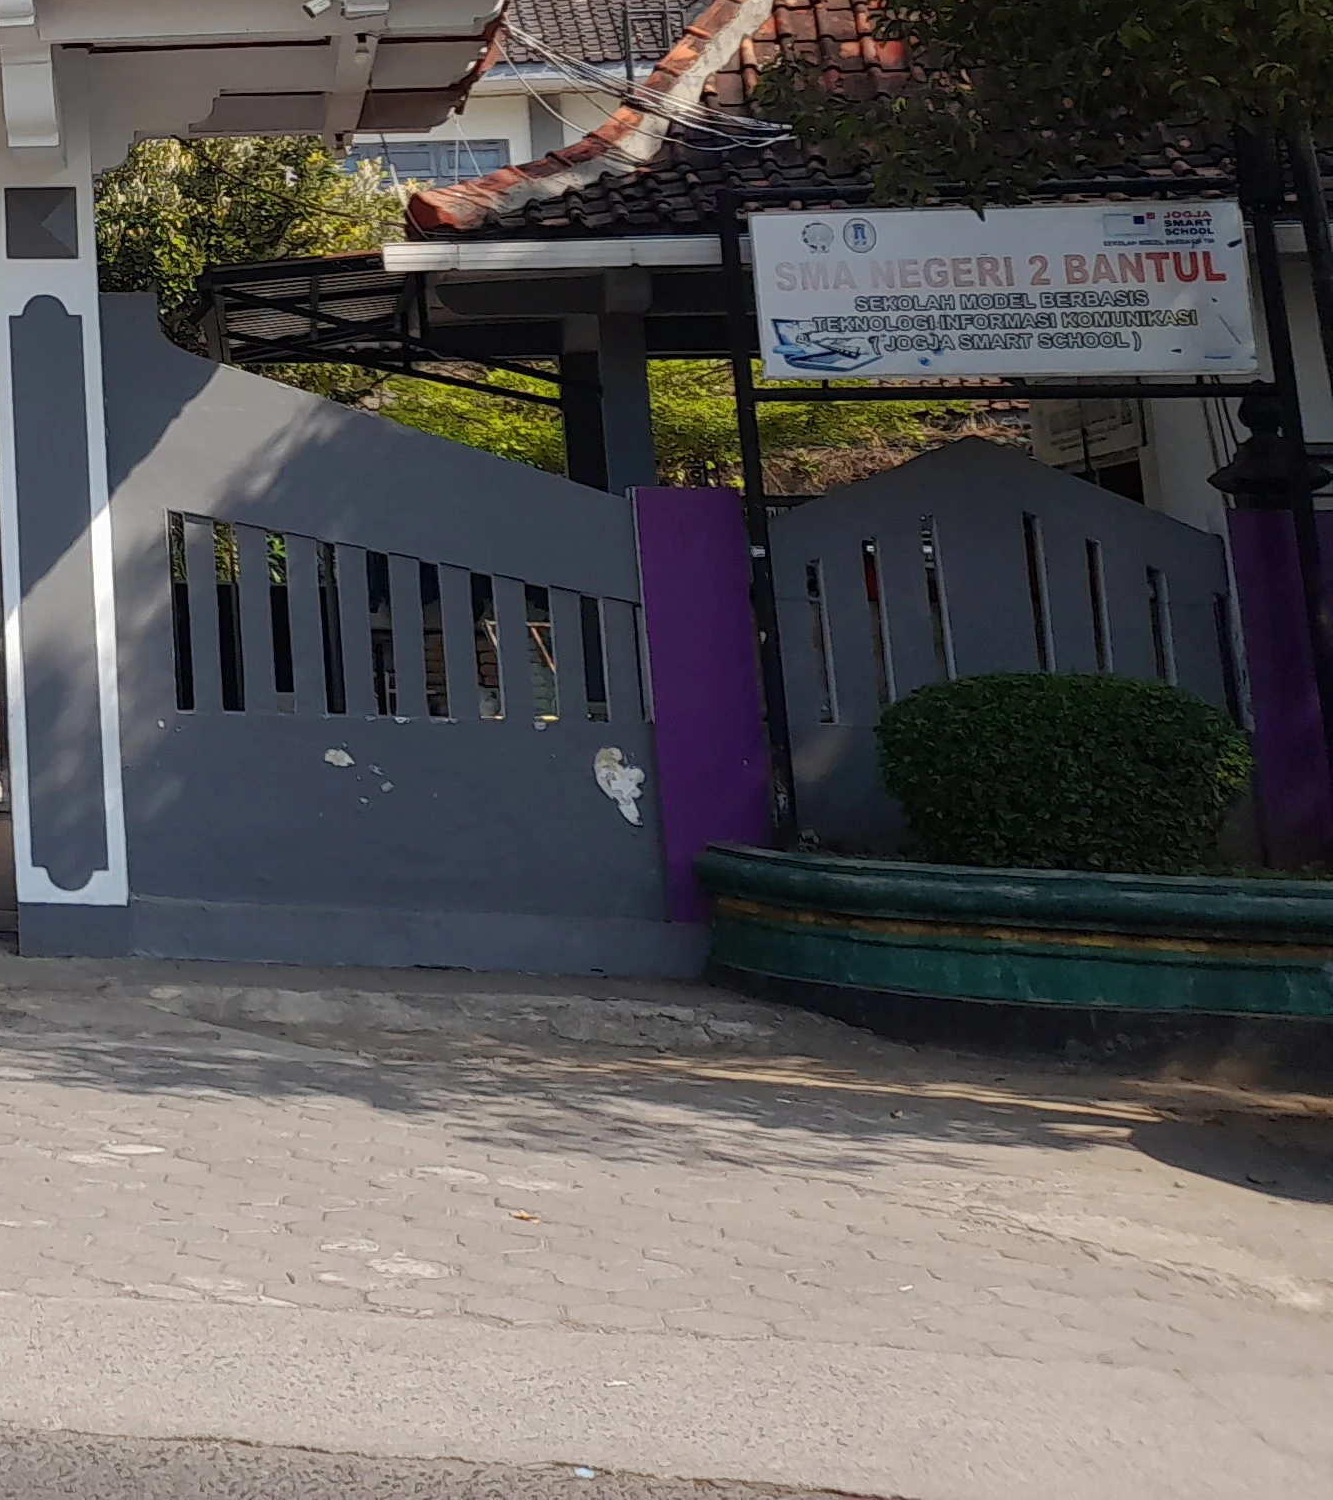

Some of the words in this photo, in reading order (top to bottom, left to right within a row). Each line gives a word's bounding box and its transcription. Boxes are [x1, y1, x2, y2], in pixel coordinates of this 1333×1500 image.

[1163, 210, 1213, 219] JOGJA
[1163, 219, 1213, 228] SMART
[1164, 227, 1215, 236] SCHOOL
[774, 260, 858, 291] SMA
[869, 255, 1015, 290] NEGERI
[1028, 254, 1052, 286] 2
[1063, 250, 1228, 285] BANTUL
[854, 293, 956, 312] SEKOLAH
[959, 292, 1036, 311] MODEL
[1039, 289, 1150, 309] BERBASIS
[811, 313, 934, 333] TEKNOLOGI
[939, 311, 1058, 332] INFORMASI
[1061, 308, 1199, 329] KOMUNIKASI
[958, 332, 1035, 351] SMART
